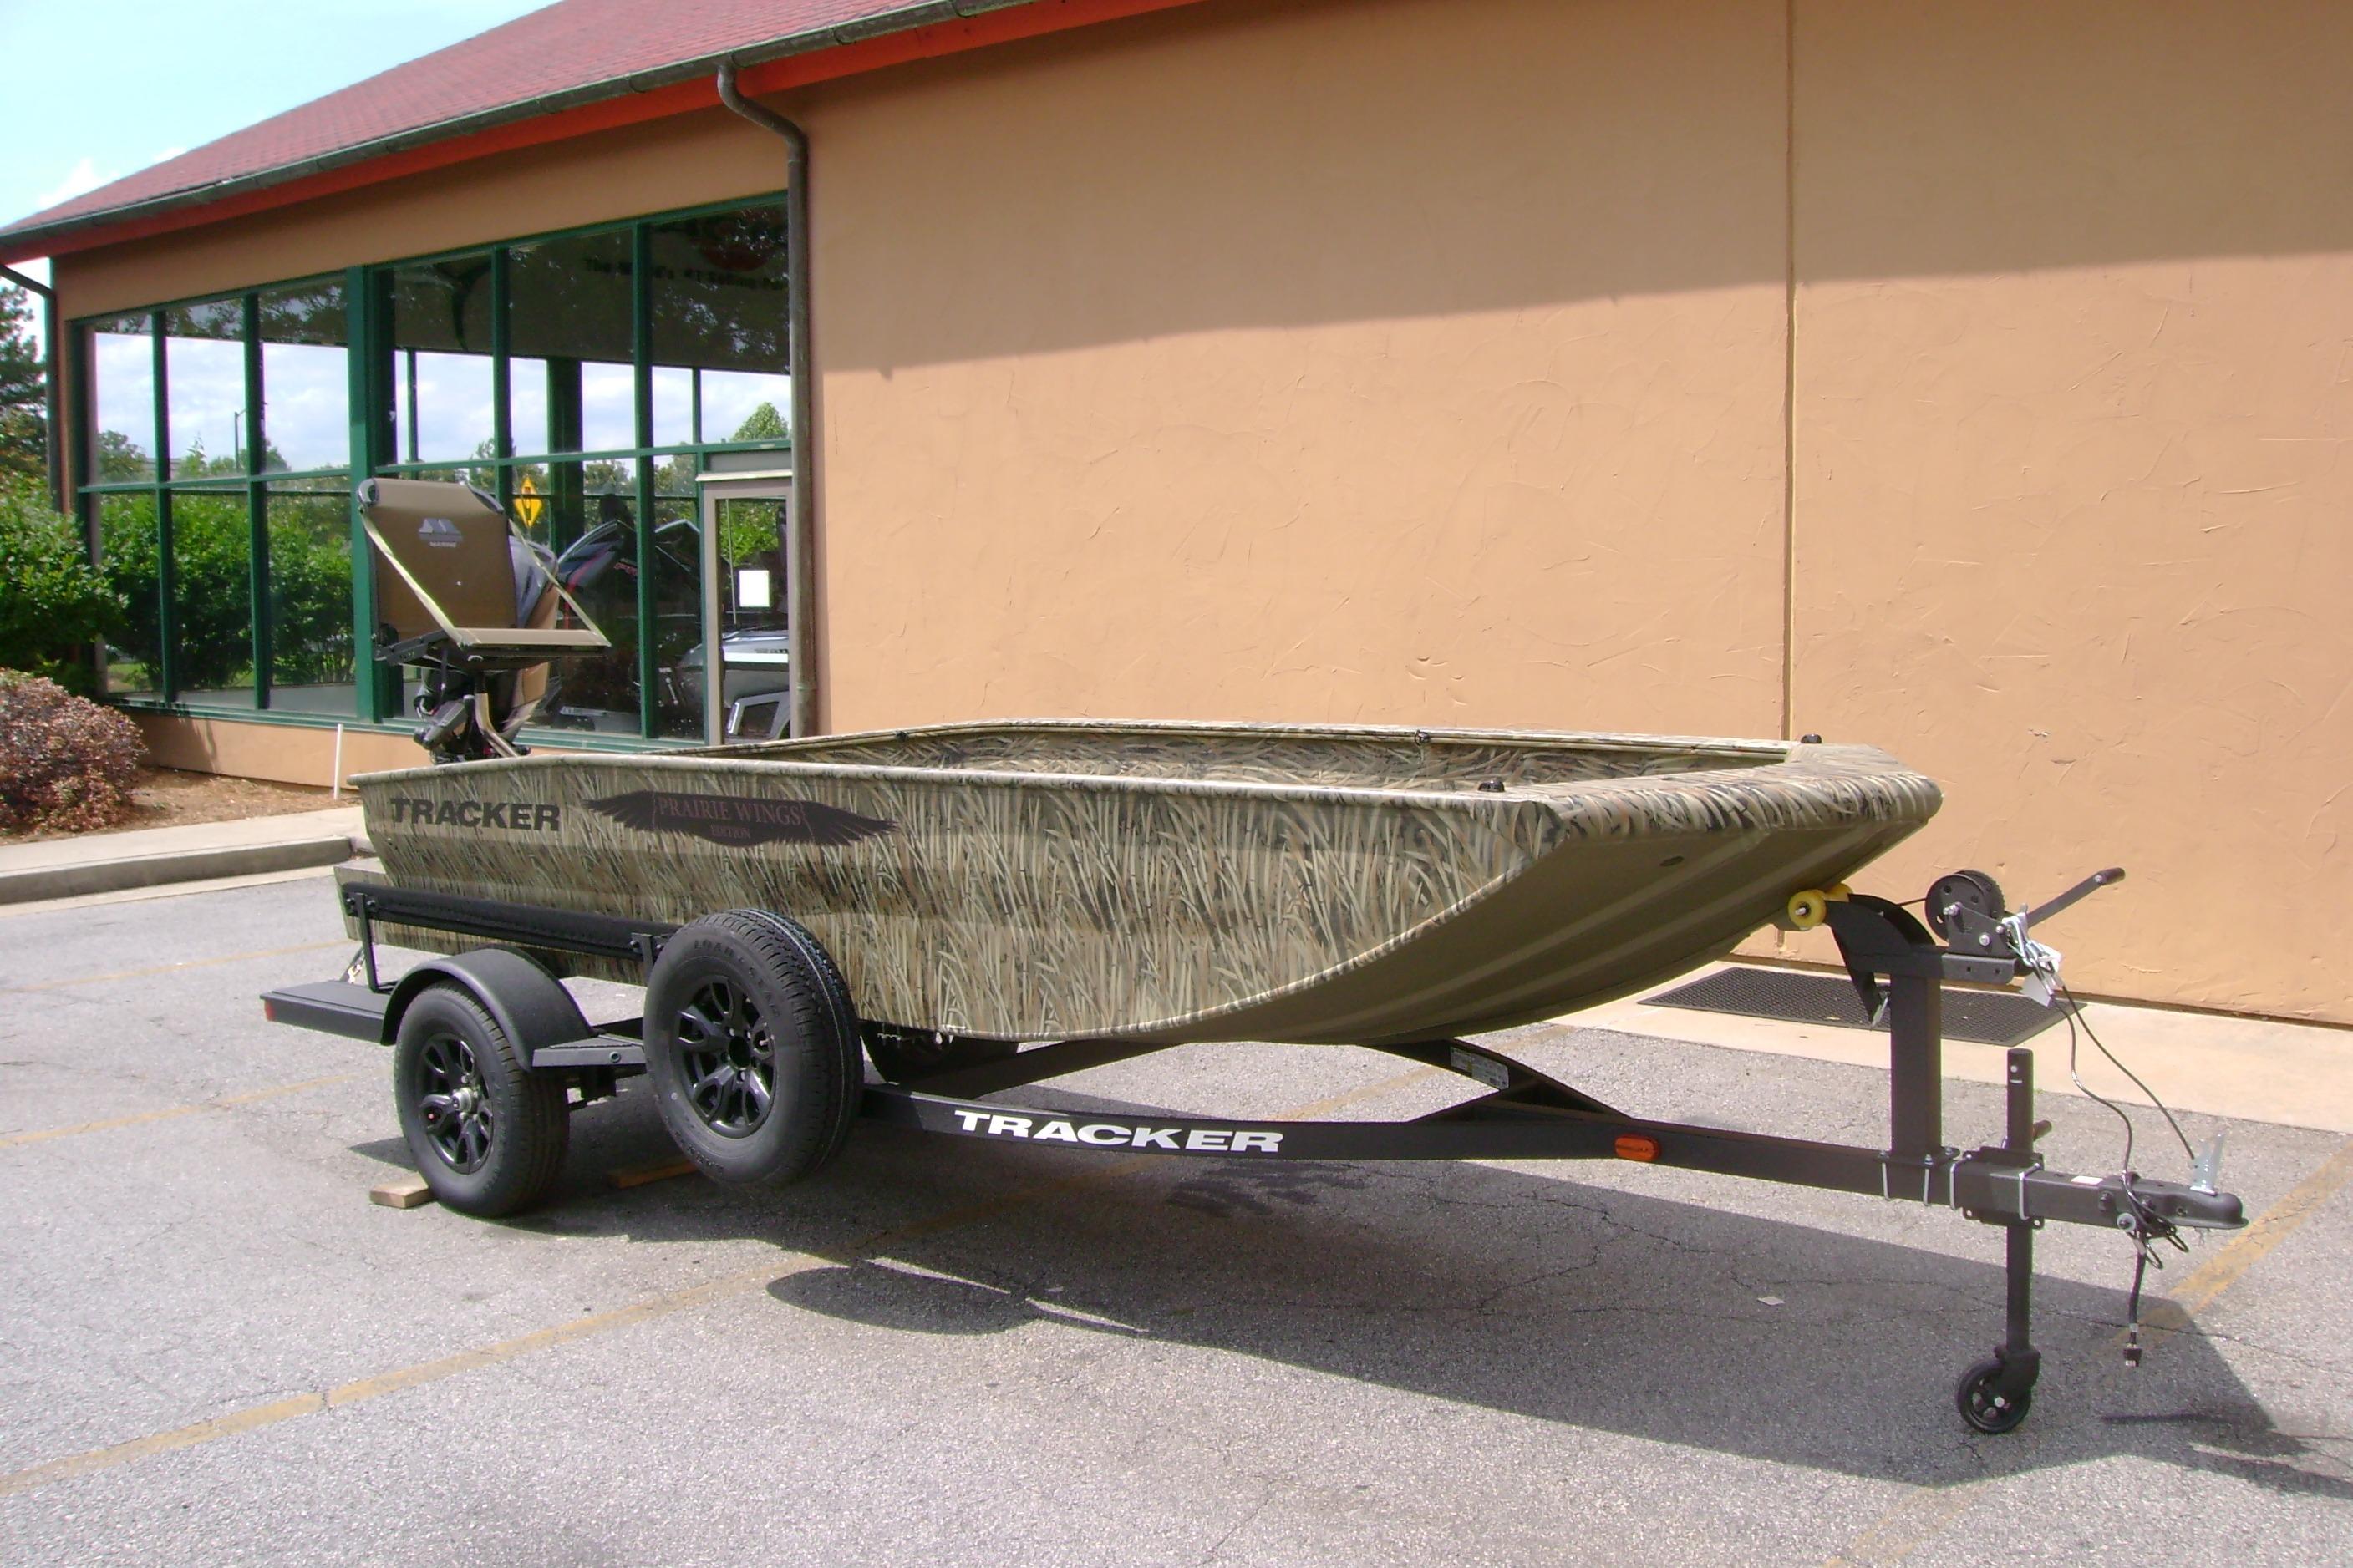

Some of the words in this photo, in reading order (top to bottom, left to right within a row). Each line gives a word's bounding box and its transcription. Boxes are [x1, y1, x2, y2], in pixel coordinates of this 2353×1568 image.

[389, 798, 561, 832] TRACKER
[658, 796, 731, 820] PRAIRIE
[734, 801, 802, 825] WINGS
[710, 824, 751, 838] EDITION
[954, 1109, 1284, 1153] TRACKER
